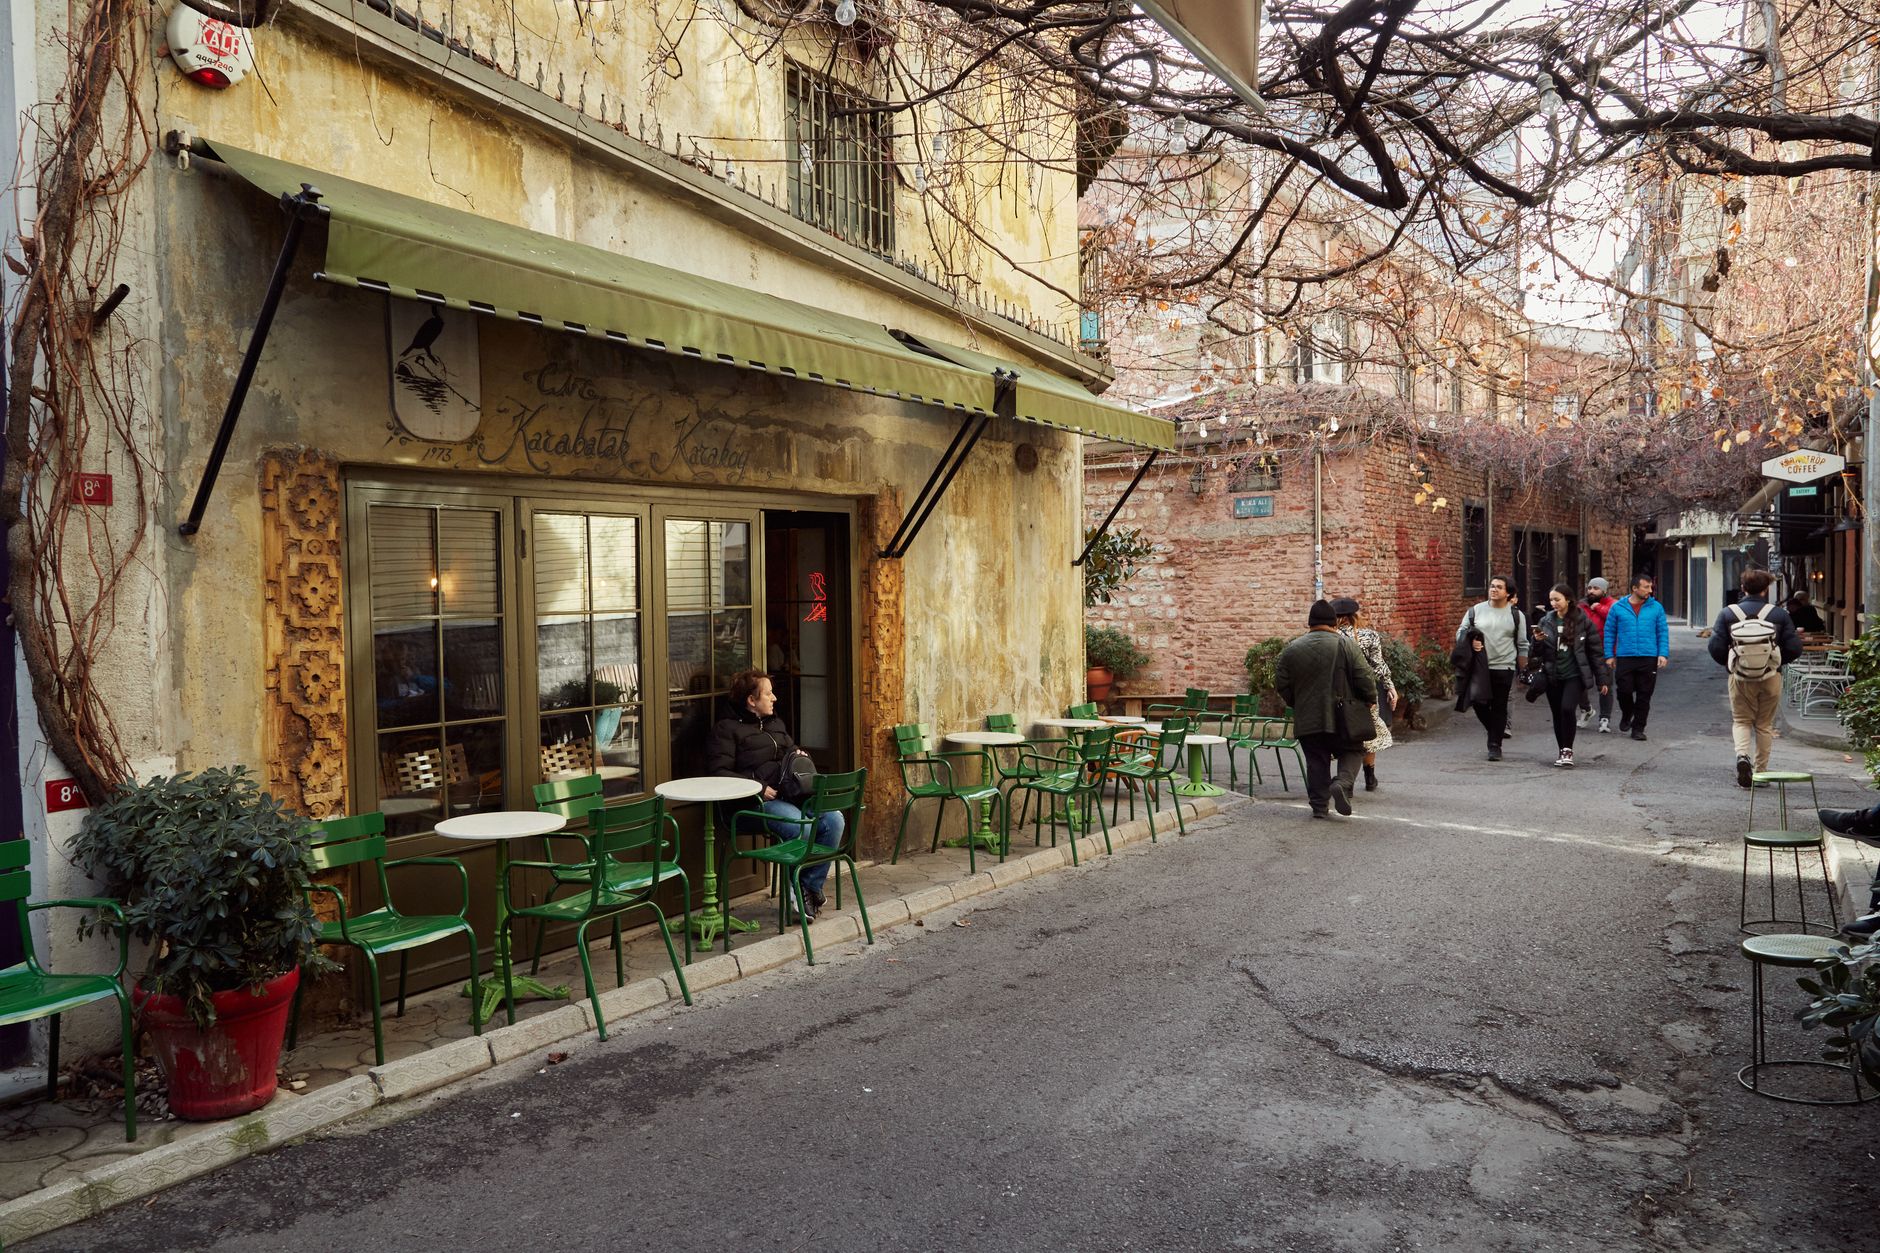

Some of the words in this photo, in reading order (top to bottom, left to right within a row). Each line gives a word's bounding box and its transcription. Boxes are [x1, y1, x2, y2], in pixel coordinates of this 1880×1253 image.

[195, 25, 241, 56] KALE
[421, 446, 453, 462] 1973
[1788, 464, 1817, 474] COFFEE
[84, 480, 101, 497] 8A
[60, 785, 79, 803] 8A
